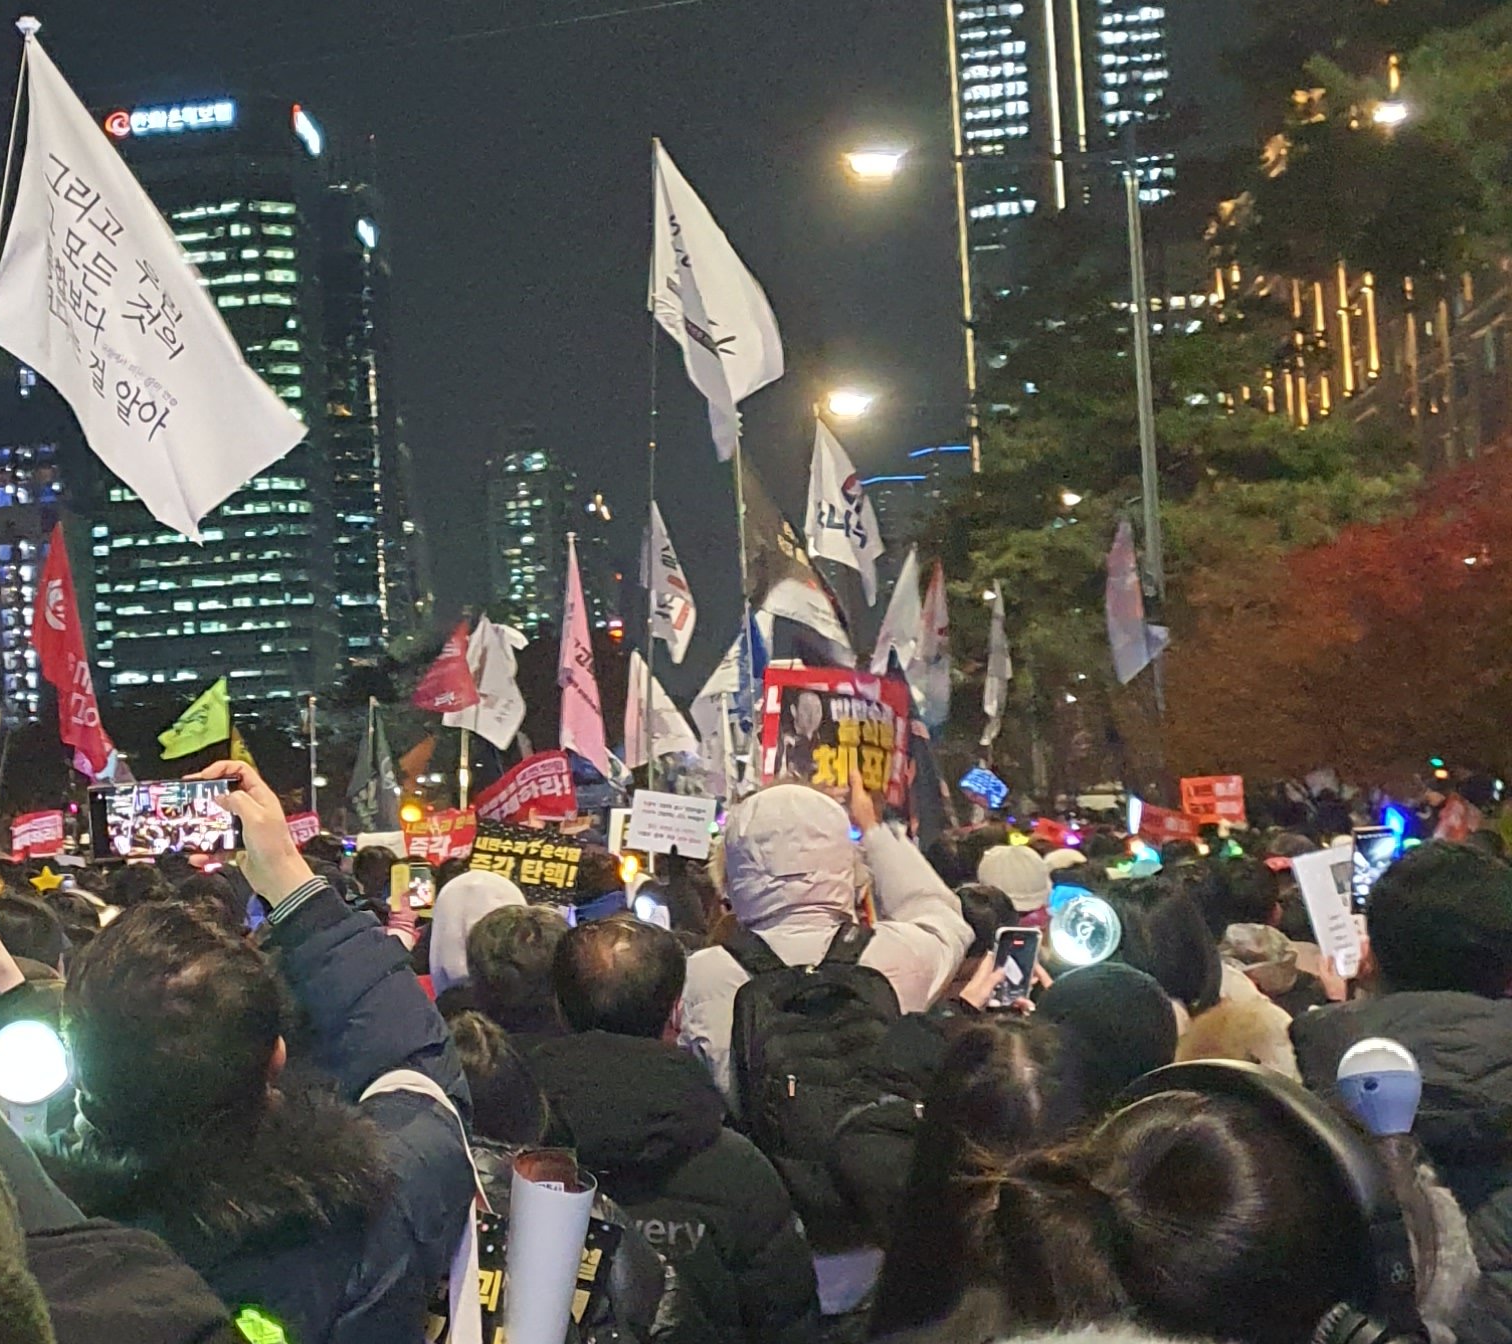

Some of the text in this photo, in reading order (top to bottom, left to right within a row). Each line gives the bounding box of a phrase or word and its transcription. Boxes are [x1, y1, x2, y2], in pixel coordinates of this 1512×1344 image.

[45, 152, 125, 247] 그리고
[62, 227, 118, 296] 모든
[122, 293, 185, 360] 것의
[115, 380, 171, 443] 알아
[520, 859, 579, 888] 탄핵!
